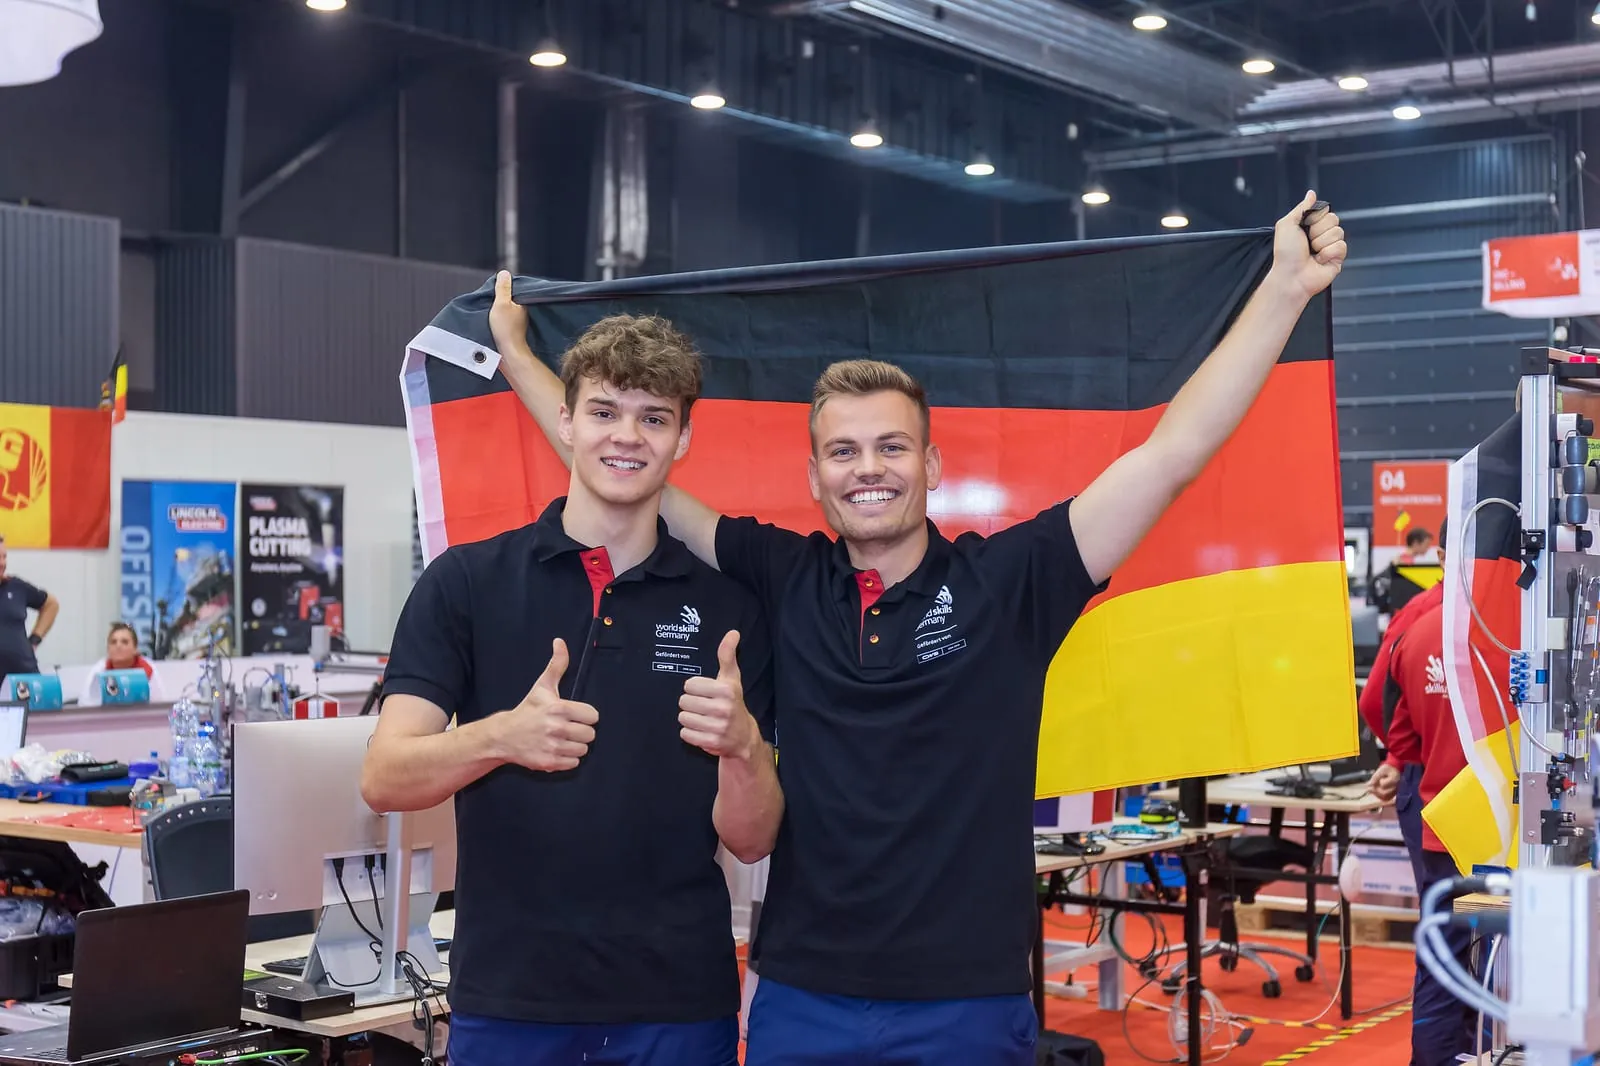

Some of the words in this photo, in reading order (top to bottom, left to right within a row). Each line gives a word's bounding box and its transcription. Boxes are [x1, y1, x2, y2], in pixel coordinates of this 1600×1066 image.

[1380, 470, 1405, 491] 04
[171, 507, 217, 519] LINCOLN
[249, 516, 309, 536] PLASMA
[249, 537, 311, 556] CUTTING
[655, 630, 690, 641] Germany
[655, 650, 680, 659] Gefördert
